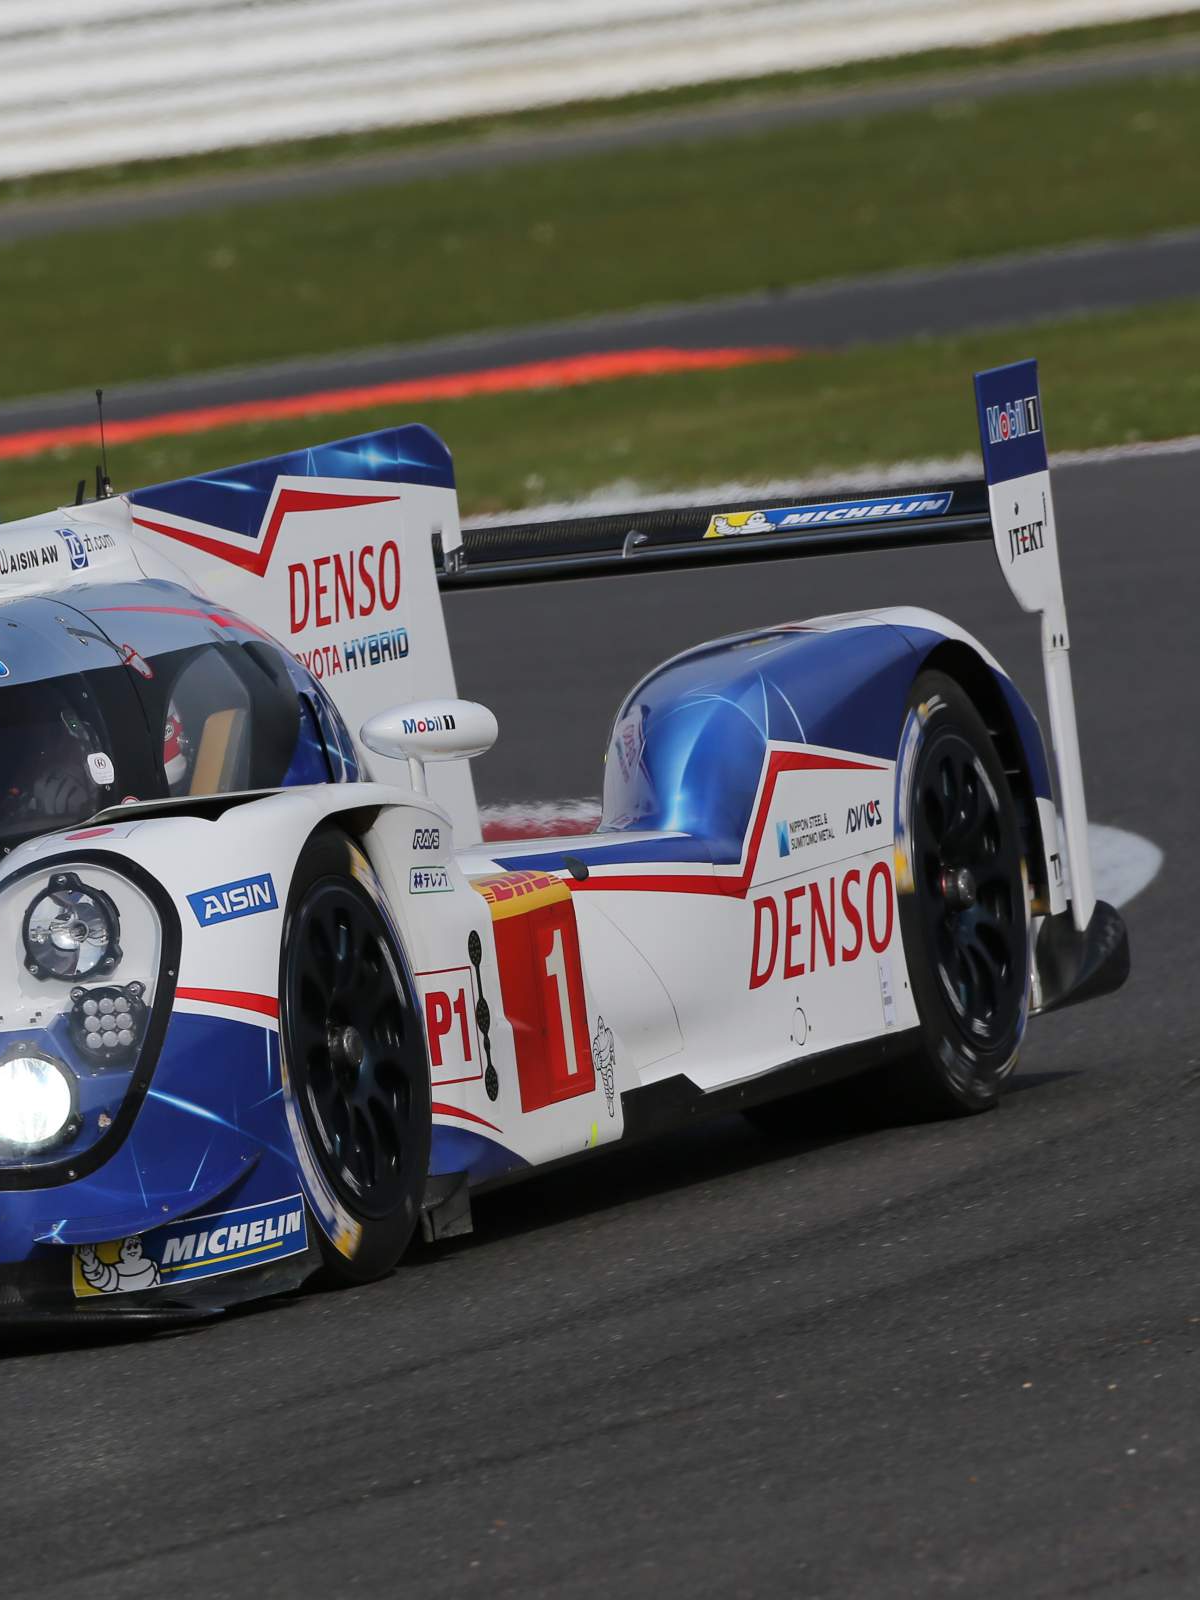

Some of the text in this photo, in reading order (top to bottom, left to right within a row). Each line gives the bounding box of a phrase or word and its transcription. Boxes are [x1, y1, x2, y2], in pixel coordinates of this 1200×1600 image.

[986, 400, 1025, 444] Mobil
[779, 499, 945, 526] MICHELIN
[10, 549, 40, 573] AISIN
[41, 545, 59, 566] AW
[1008, 520, 1045, 564] JTEKT
[288, 540, 401, 634] DENSO
[343, 627, 409, 672] HYBRID
[402, 716, 443, 734] Mobil
[412, 829, 440, 849] RAYS
[203, 884, 272, 920] AISIN
[749, 861, 894, 990] DENSO
[545, 928, 578, 1076] 1
[425, 987, 473, 1066] P1
[161, 1209, 302, 1265] MICHELIN
